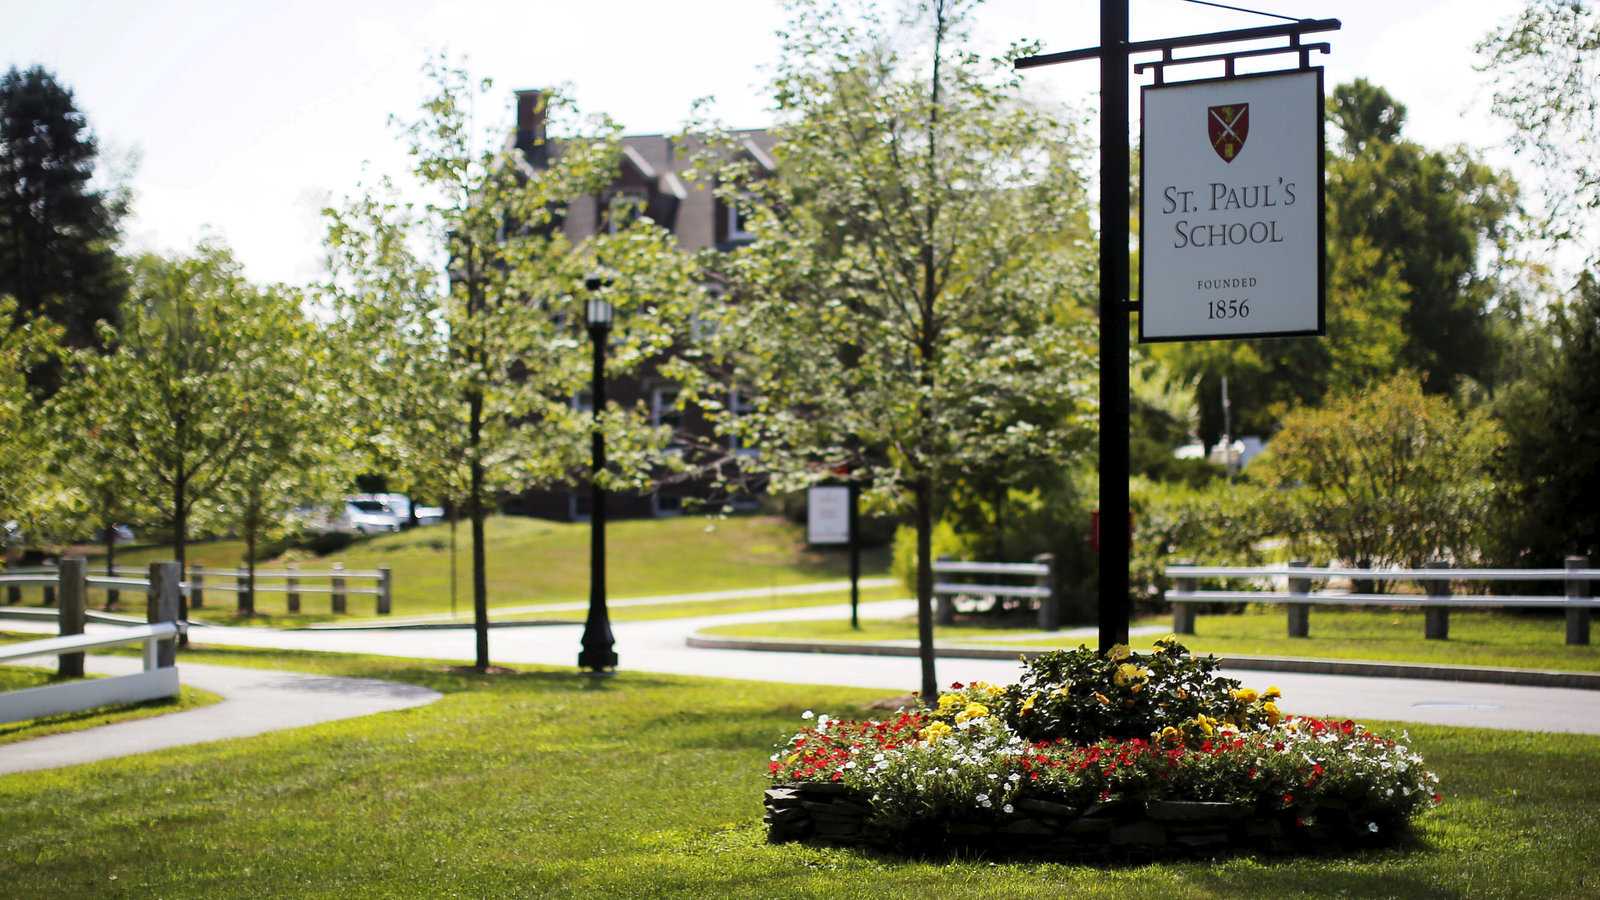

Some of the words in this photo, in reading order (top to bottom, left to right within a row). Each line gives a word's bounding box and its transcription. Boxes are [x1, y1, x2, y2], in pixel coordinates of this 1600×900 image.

[1174, 220, 1283, 248] SCHOOL
[1197, 277, 1257, 289] FOUNDED
[1208, 298, 1250, 319] 1856
